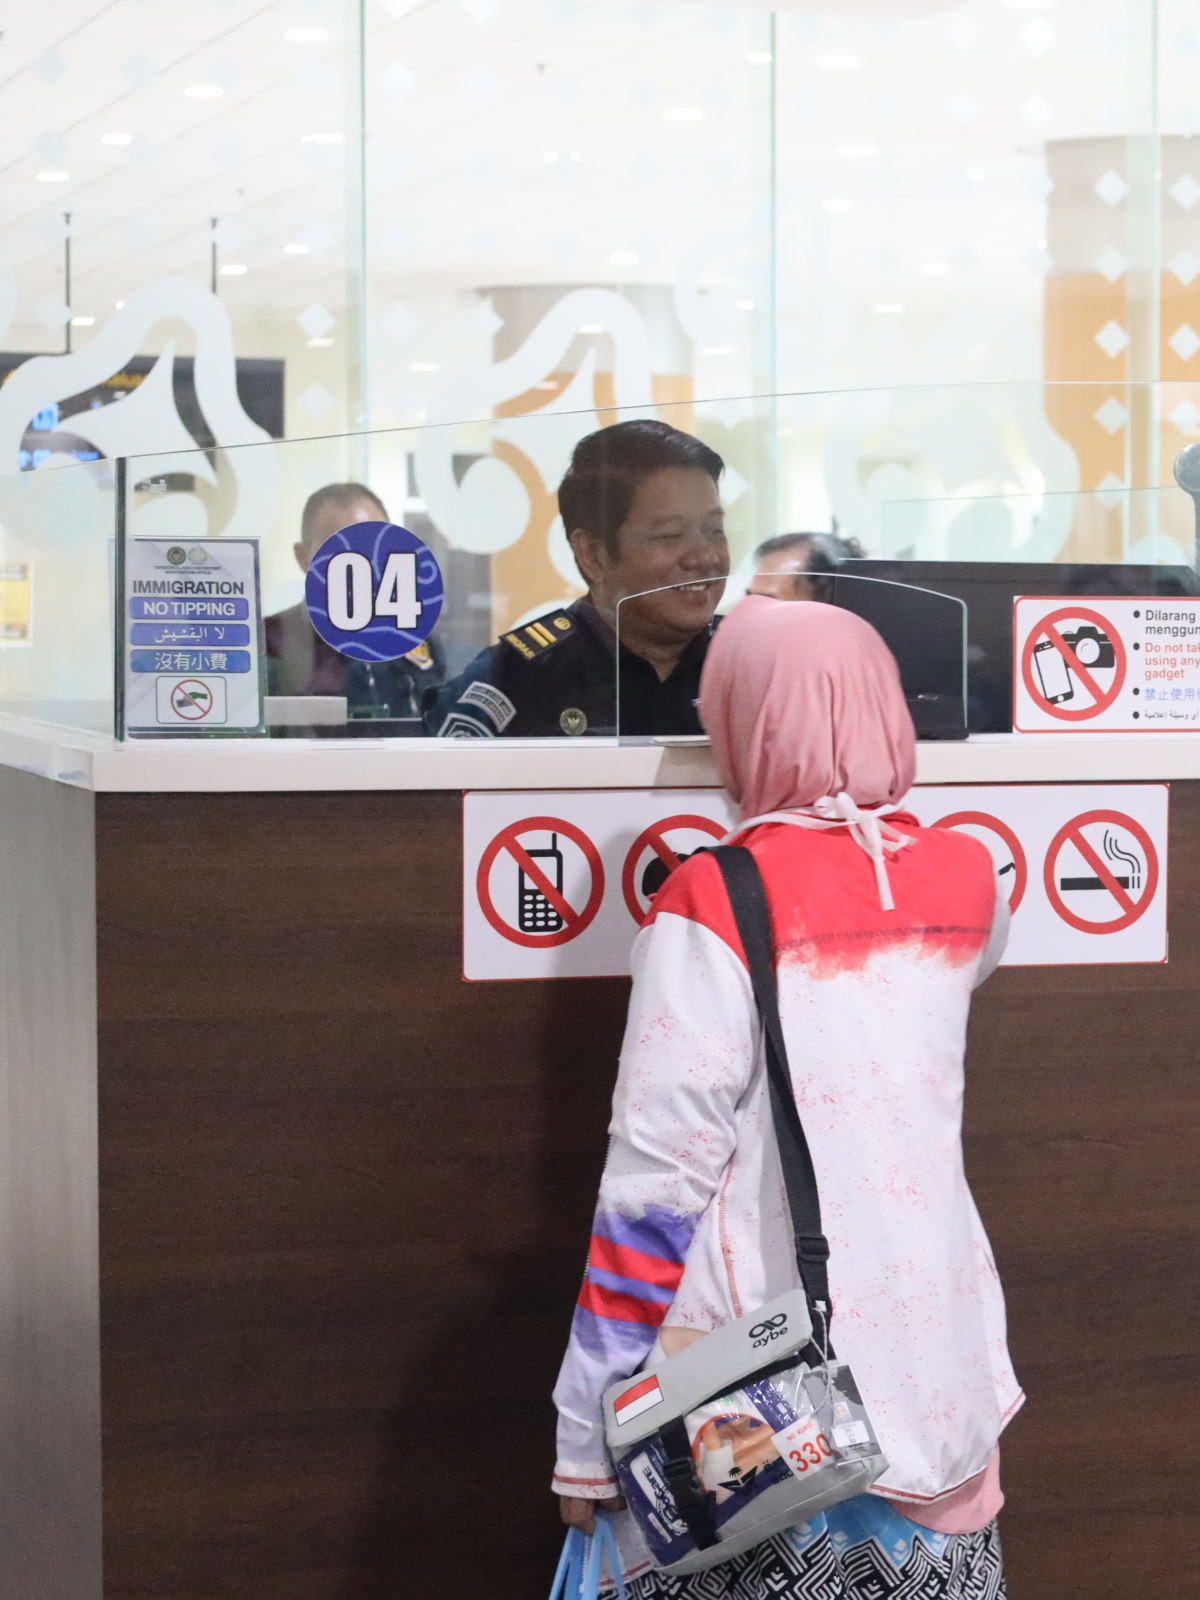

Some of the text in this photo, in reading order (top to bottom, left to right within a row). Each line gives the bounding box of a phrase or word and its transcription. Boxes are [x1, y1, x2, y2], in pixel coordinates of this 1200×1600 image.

[132, 580, 244, 595] IMMIGRATION
[326, 551, 422, 632] 04
[143, 601, 236, 616] NO TIPPING
[1145, 609, 1196, 623] Dilarang
[1145, 642, 1162, 654] Do
[1165, 643, 1184, 654] not
[155, 652, 228, 671] 沒有小費
[1144, 656, 1177, 669] using
[1144, 668, 1186, 681] gadget
[752, 1326, 788, 1348] aybe
[796, 1420, 815, 1436] KURSI
[788, 1433, 833, 1473] 330
